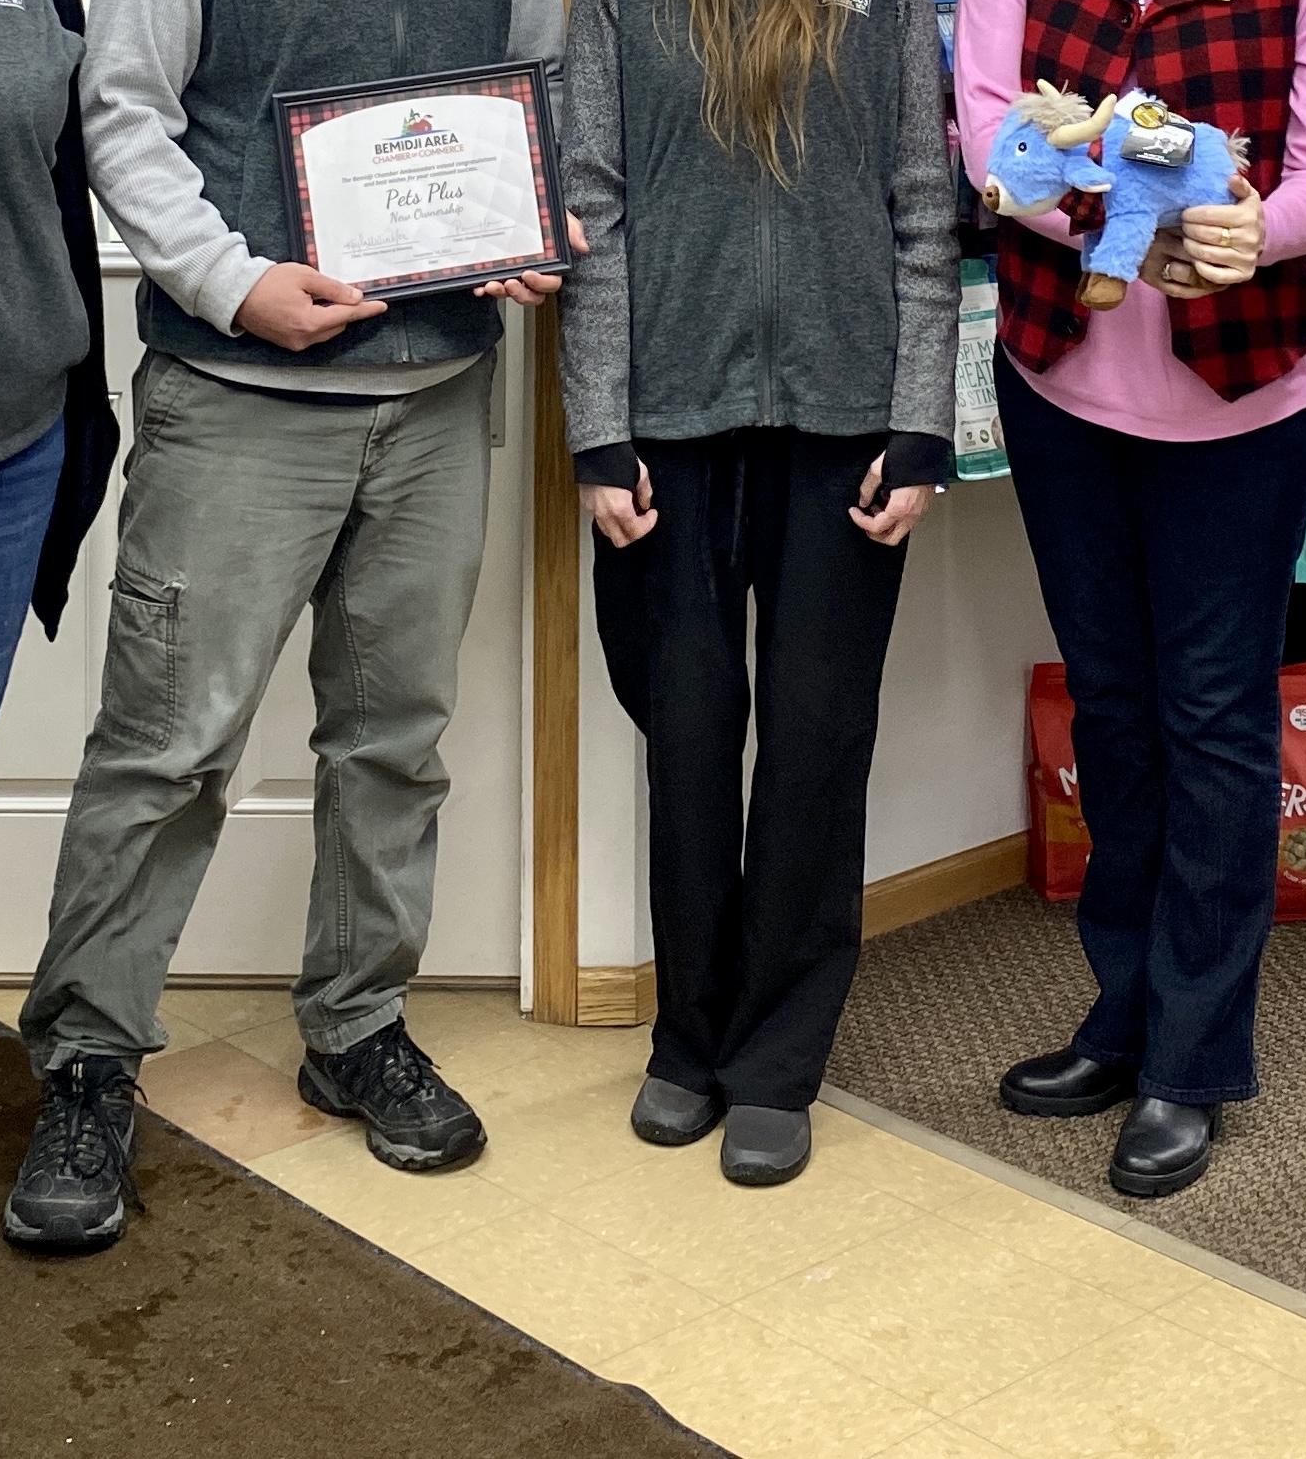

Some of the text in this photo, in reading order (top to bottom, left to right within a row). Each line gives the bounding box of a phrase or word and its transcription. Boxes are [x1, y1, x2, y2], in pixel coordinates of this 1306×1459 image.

[372, 153, 412, 165] CHAMBER
[418, 144, 465, 158] COMMERCE
[374, 133, 459, 155] BEMIDJI AREA
[385, 181, 464, 210] Pets Plus
[389, 203, 464, 225] New Ownership
